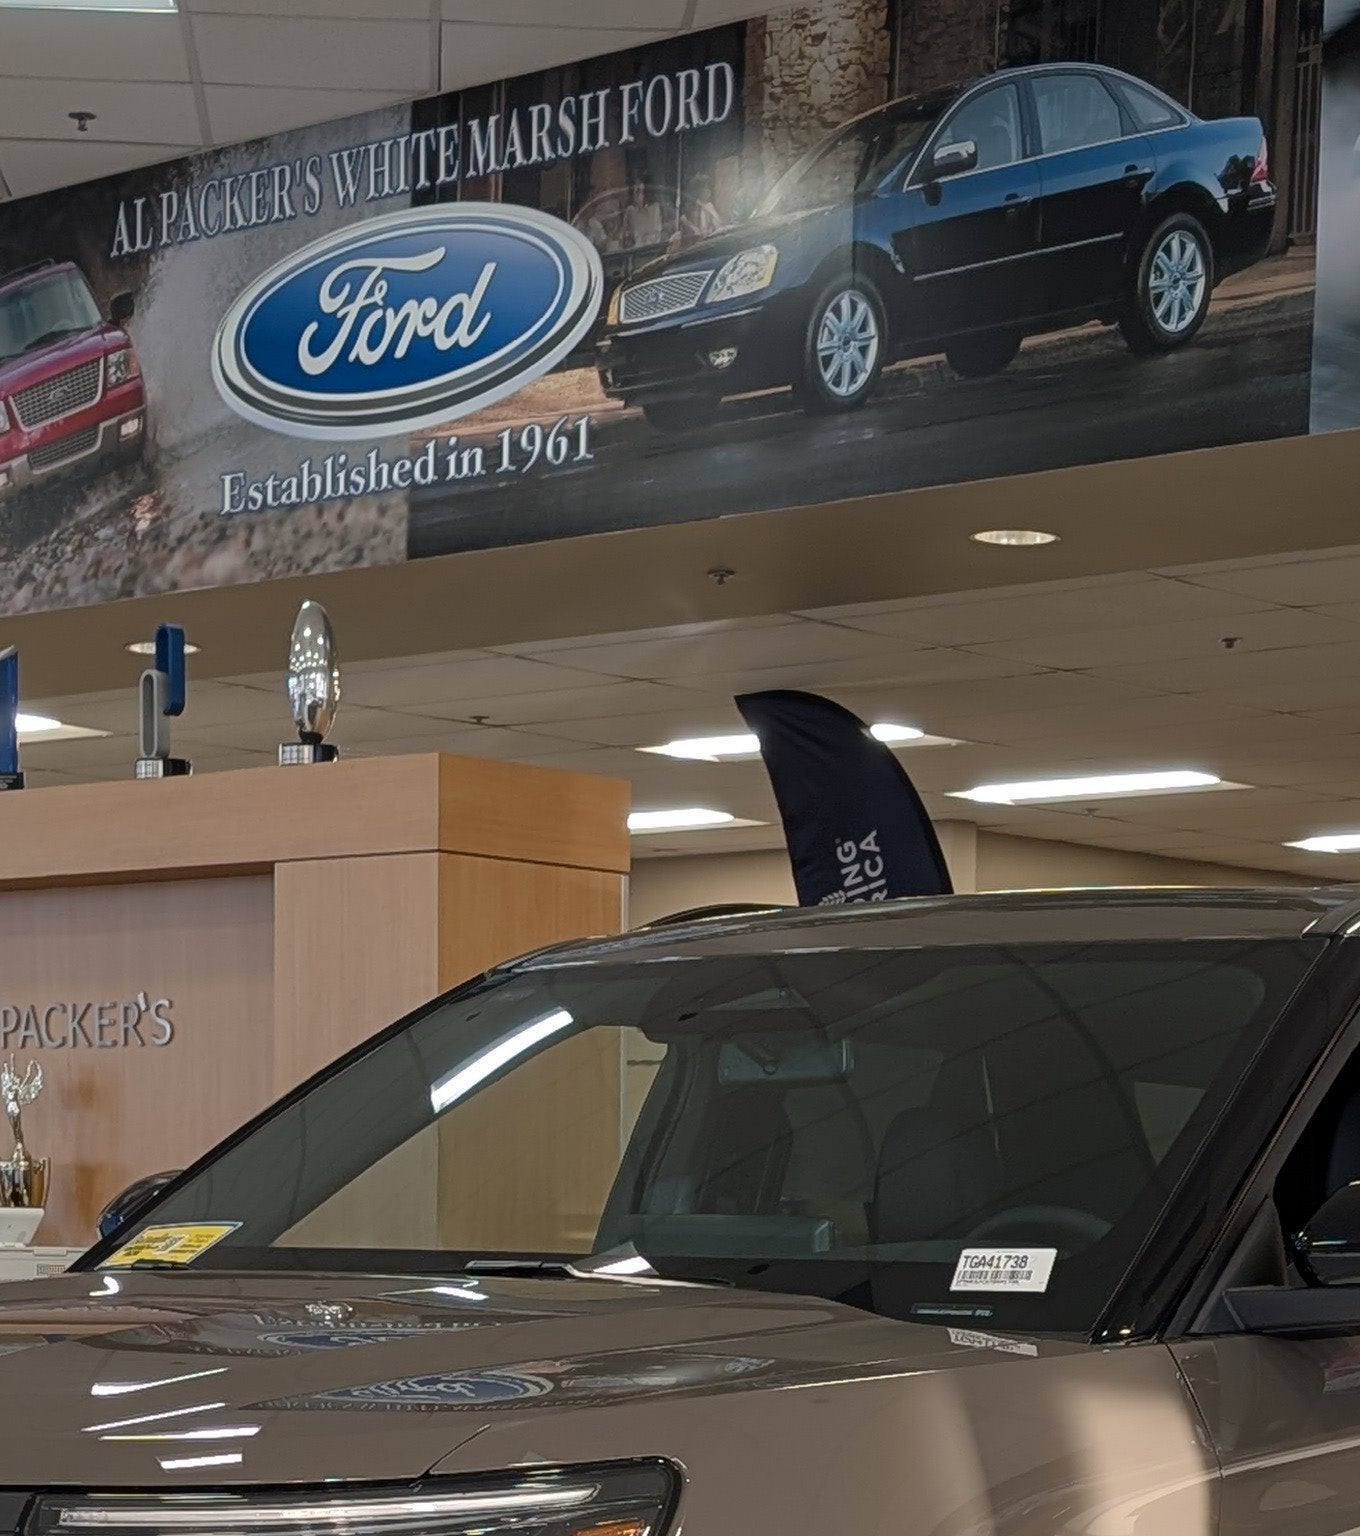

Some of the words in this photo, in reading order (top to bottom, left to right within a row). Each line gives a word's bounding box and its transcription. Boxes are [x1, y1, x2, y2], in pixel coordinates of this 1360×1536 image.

[109, 197, 154, 258] AL
[158, 154, 322, 247] PACKER'S
[328, 122, 461, 209] WHITE
[465, 87, 612, 180] MARSH
[618, 60, 735, 145] FORD
[297, 245, 496, 377] Ford
[220, 438, 438, 515] Established
[444, 435, 487, 481] in
[495, 414, 595, 475] 1961
[962, 1254, 1029, 1270] TGA41738
